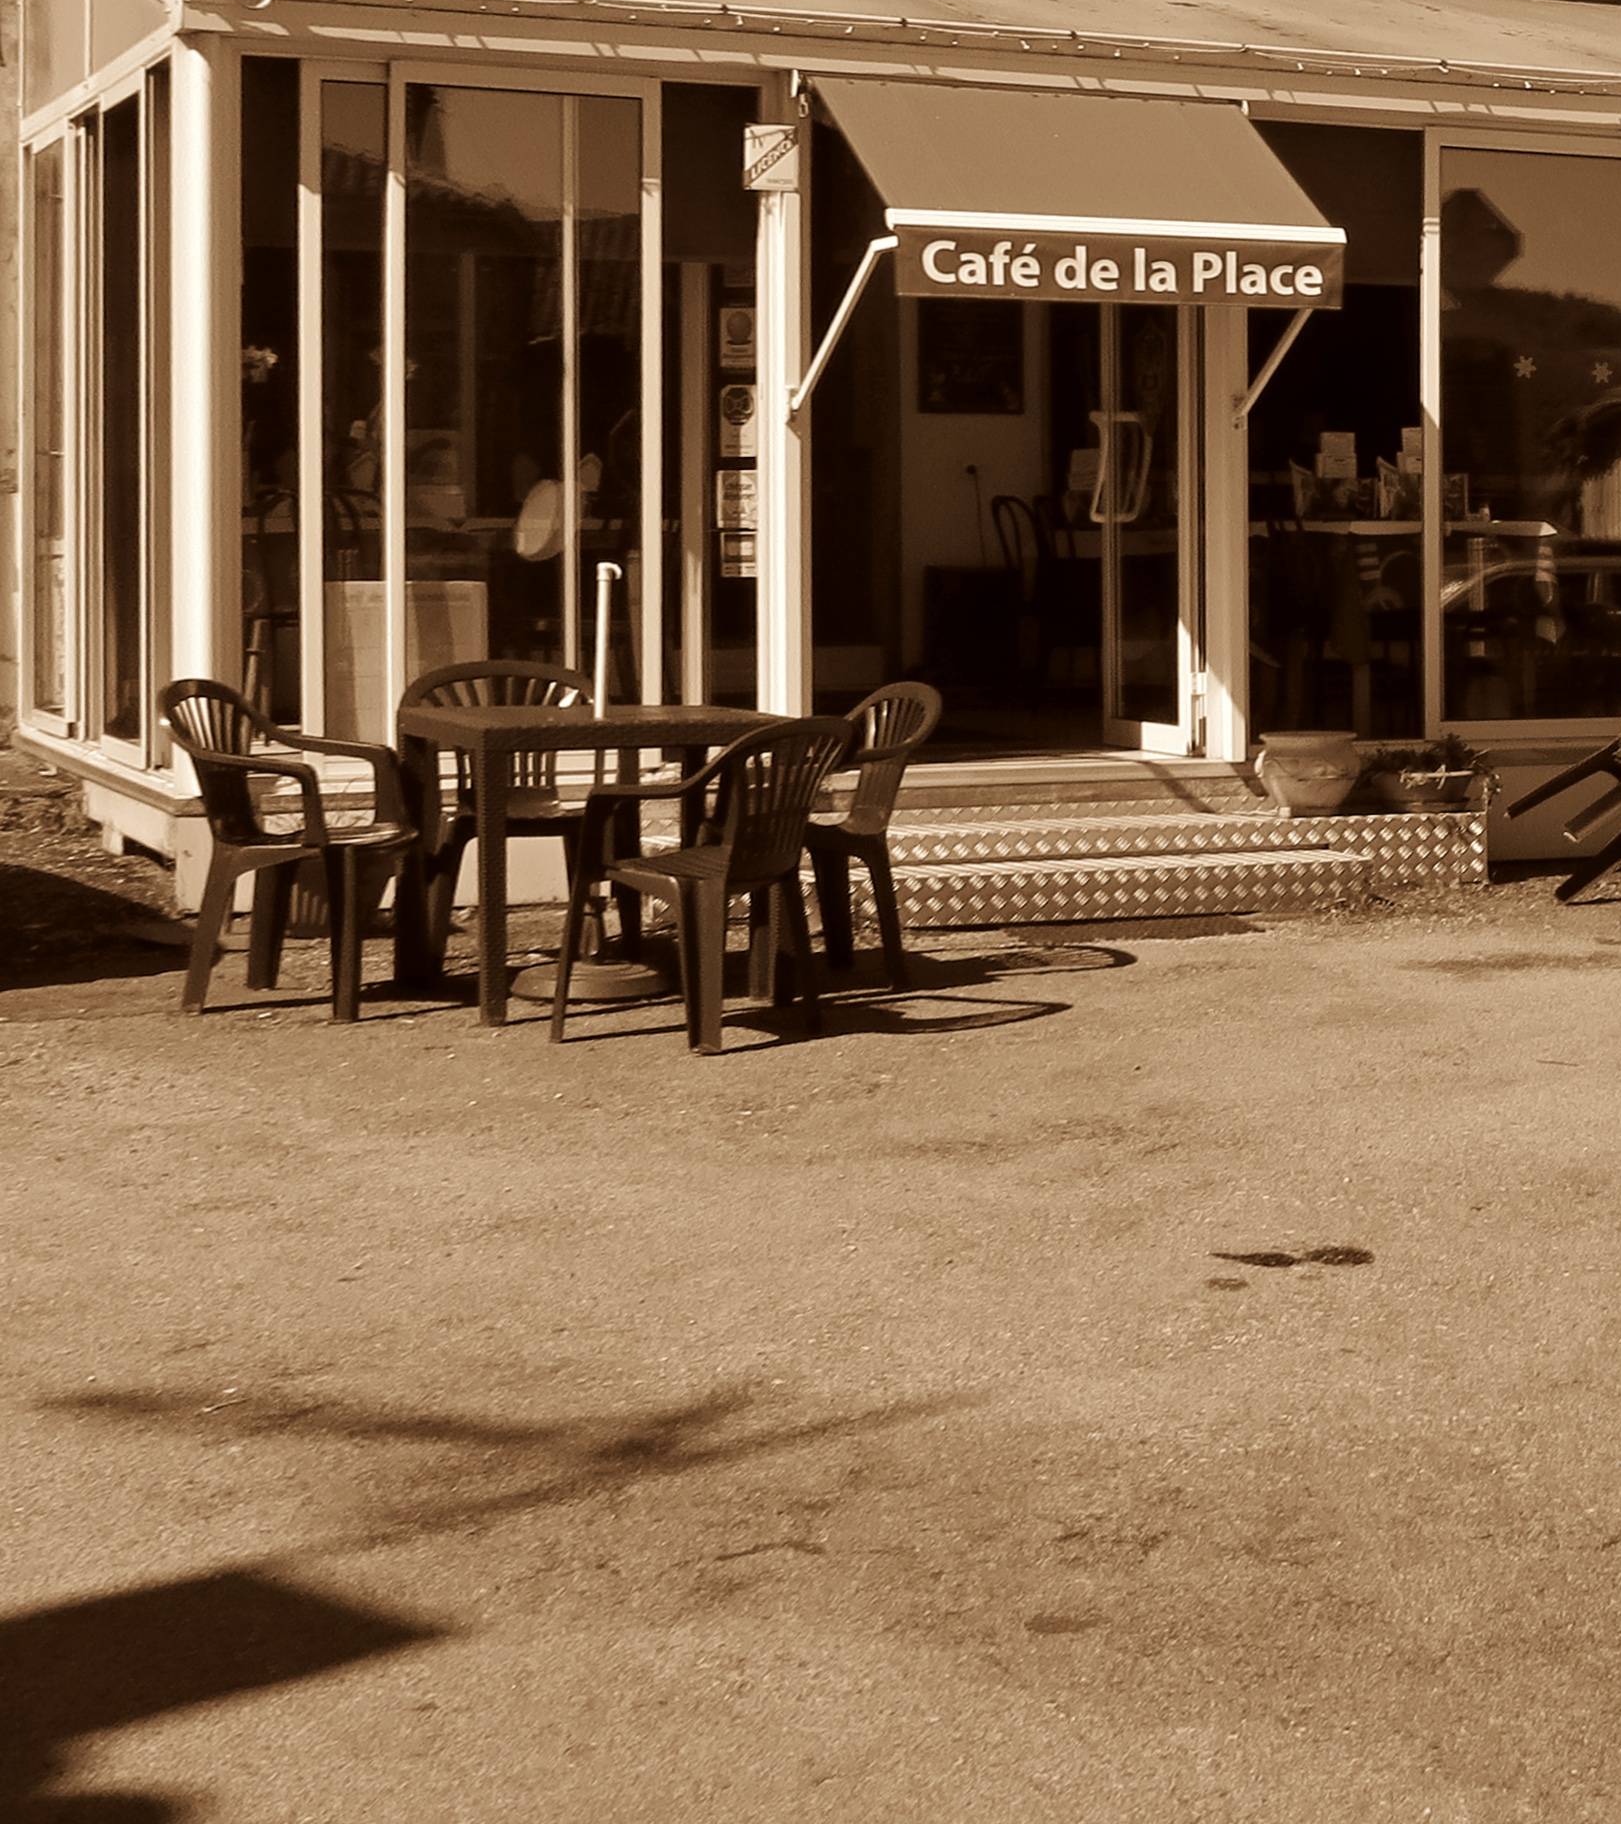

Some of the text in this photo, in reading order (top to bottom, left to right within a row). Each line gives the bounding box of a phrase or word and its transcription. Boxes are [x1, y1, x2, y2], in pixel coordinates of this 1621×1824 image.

[921, 239, 1324, 297] Café de la Place
